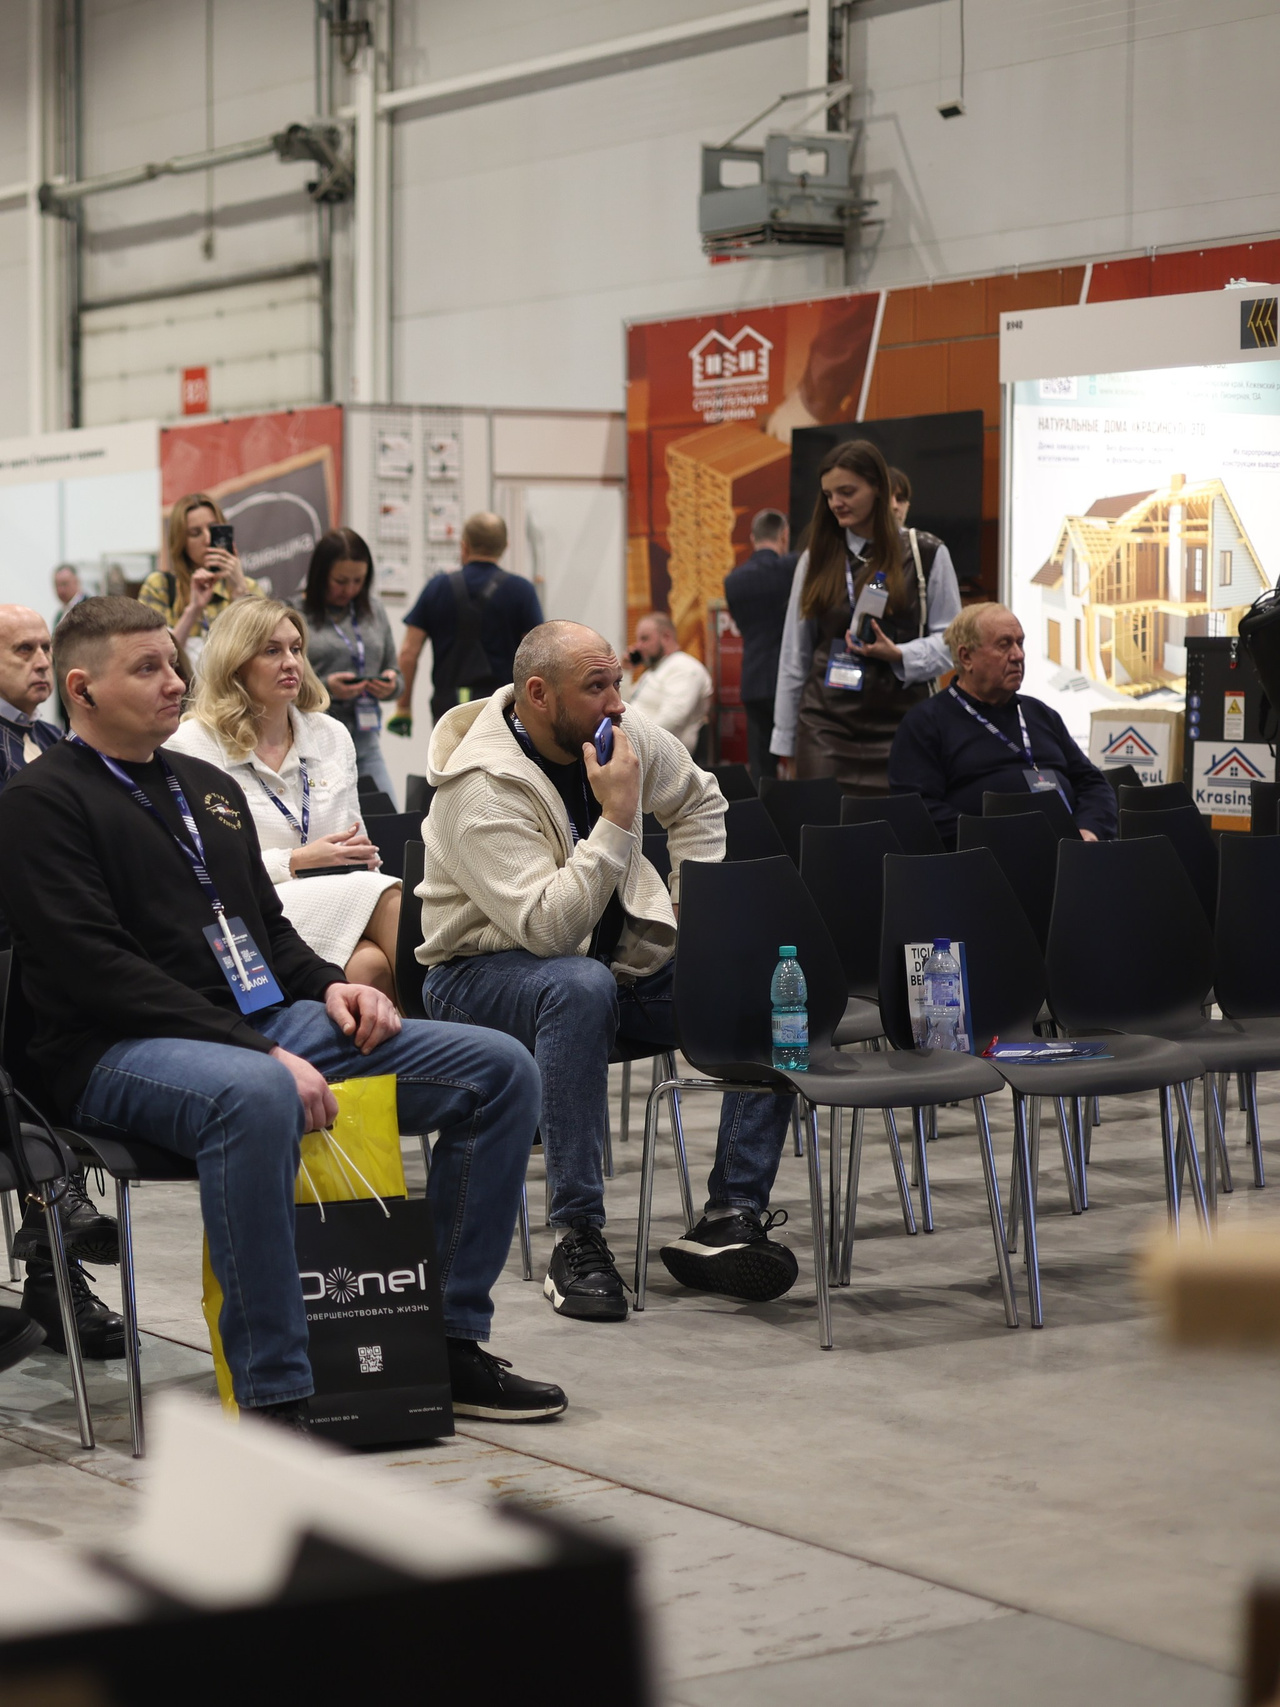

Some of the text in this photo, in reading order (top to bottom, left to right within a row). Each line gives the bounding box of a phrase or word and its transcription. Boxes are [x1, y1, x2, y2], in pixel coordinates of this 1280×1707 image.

[1038, 416, 1099, 434] НАТУРАЛЬНЫЕ
[1104, 419, 1128, 435] ДОМА
[1196, 788, 1252, 806] Krasins
[239, 975, 269, 992] ЭАЛОН
[306, 1304, 430, 1321] ОВЕРШЕНСТВОВАТЬ ЖИЗНЬ
